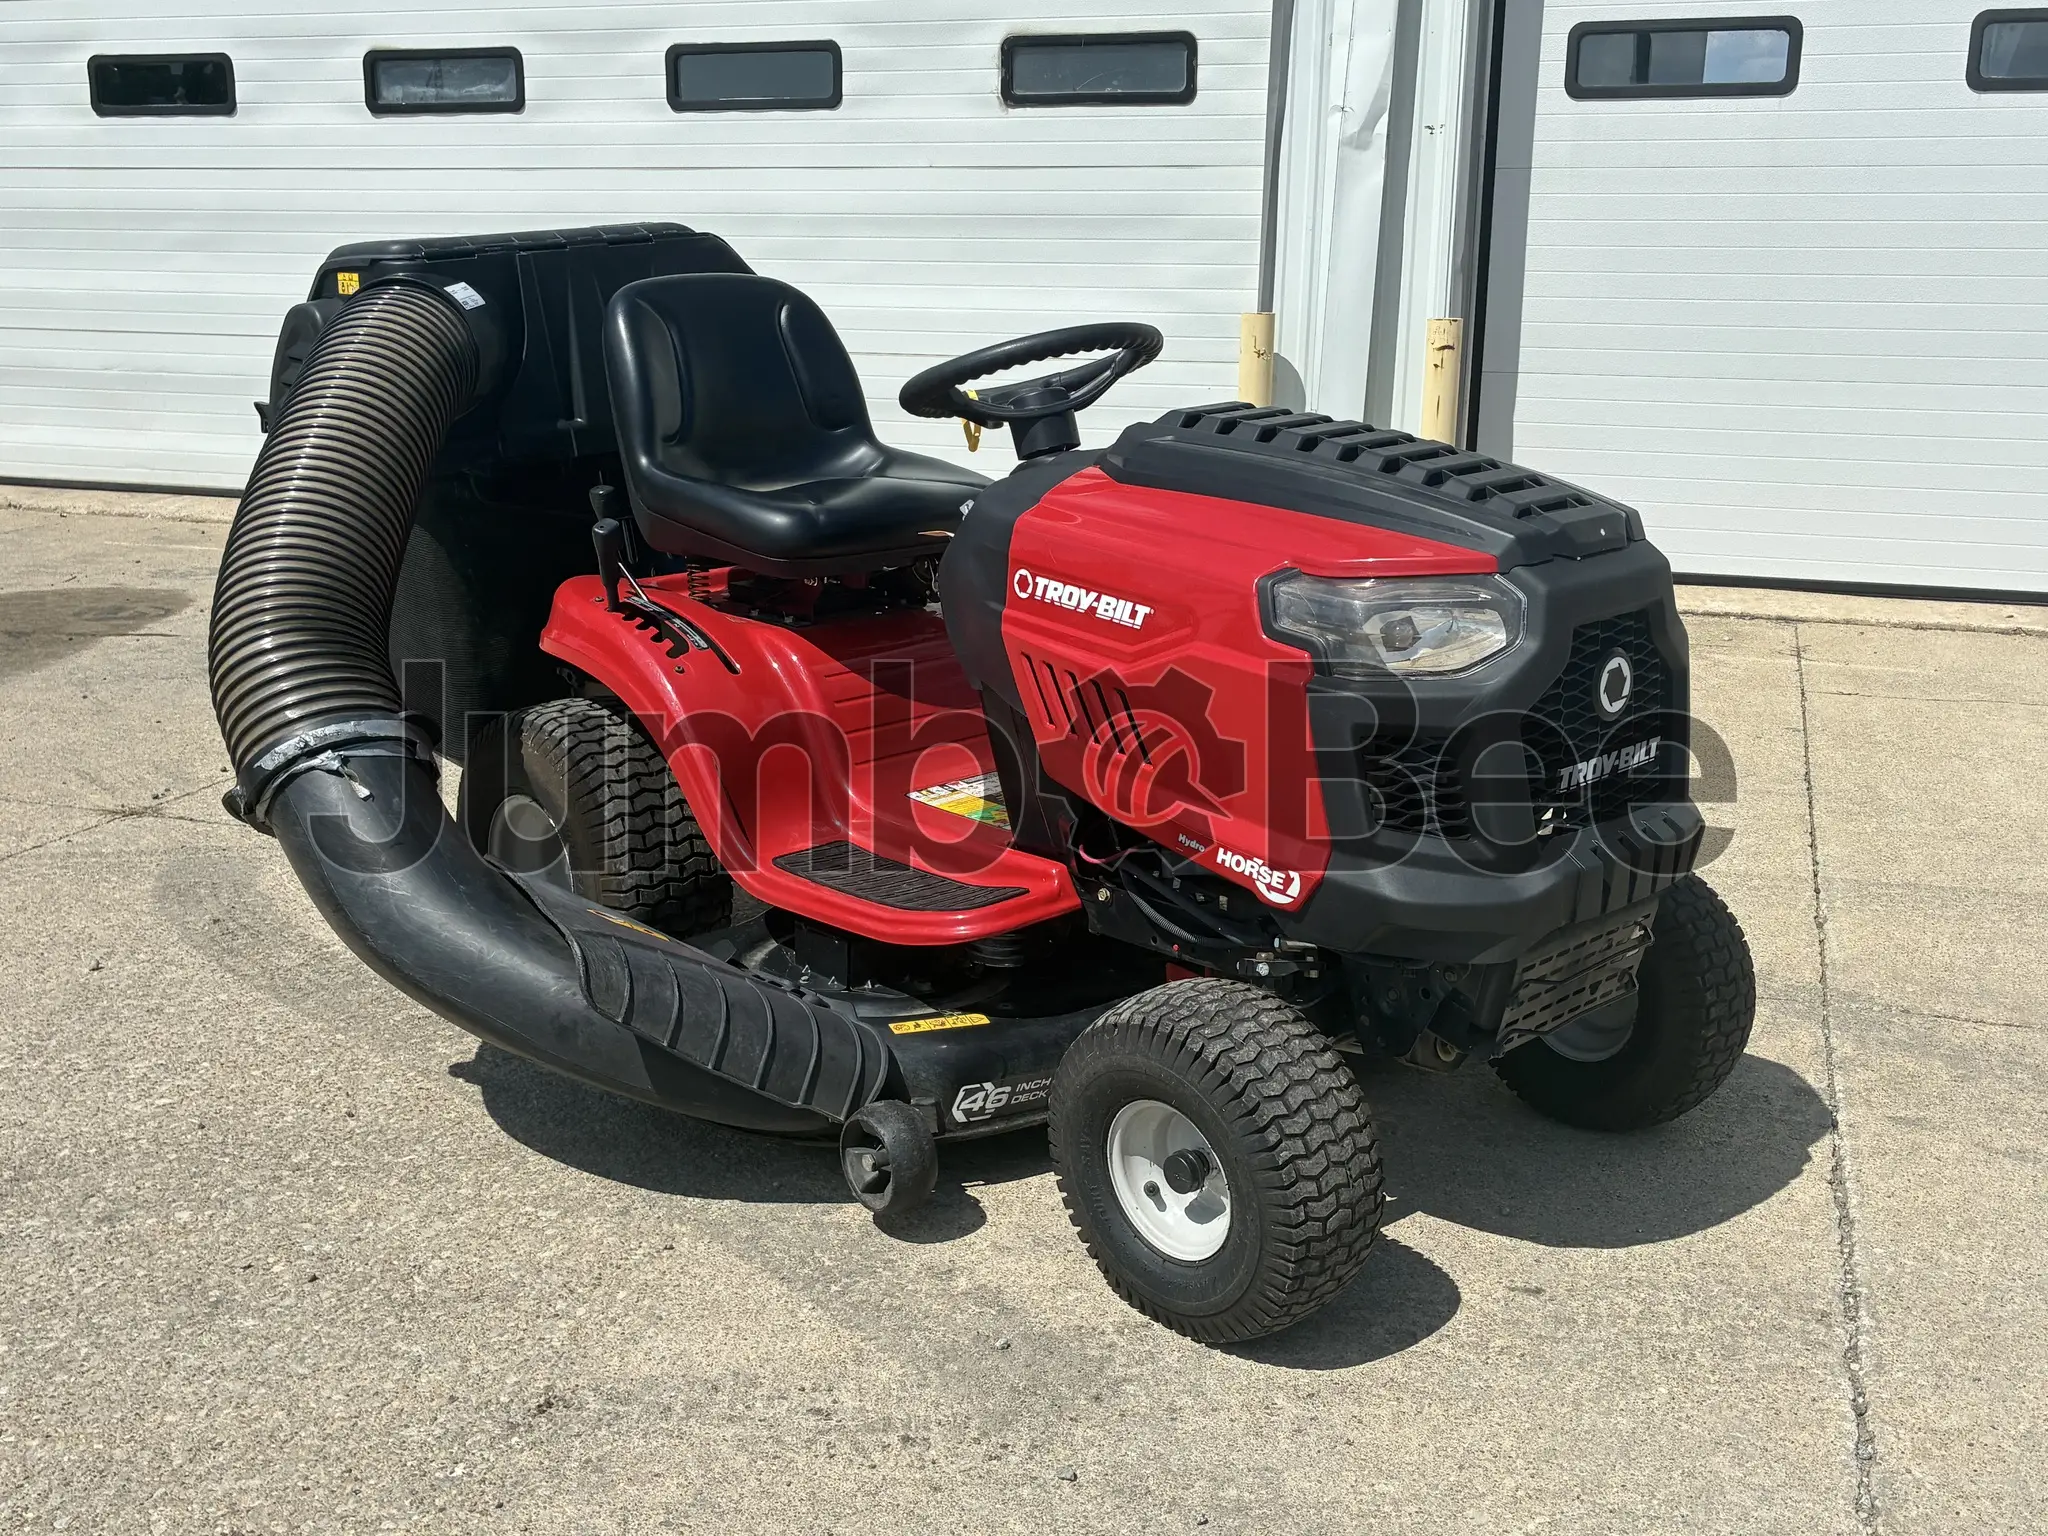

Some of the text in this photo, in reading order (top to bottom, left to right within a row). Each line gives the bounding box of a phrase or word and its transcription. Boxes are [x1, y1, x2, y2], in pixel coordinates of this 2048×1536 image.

[1034, 575, 1151, 630] TROY-BILT
[1557, 735, 1661, 793] TROY-BILT
[1178, 833, 1286, 890] Hydro HORSE
[958, 1086, 1012, 1113] 46
[1010, 1089, 1050, 1105] DECK
[1015, 1077, 1052, 1092] INCH
